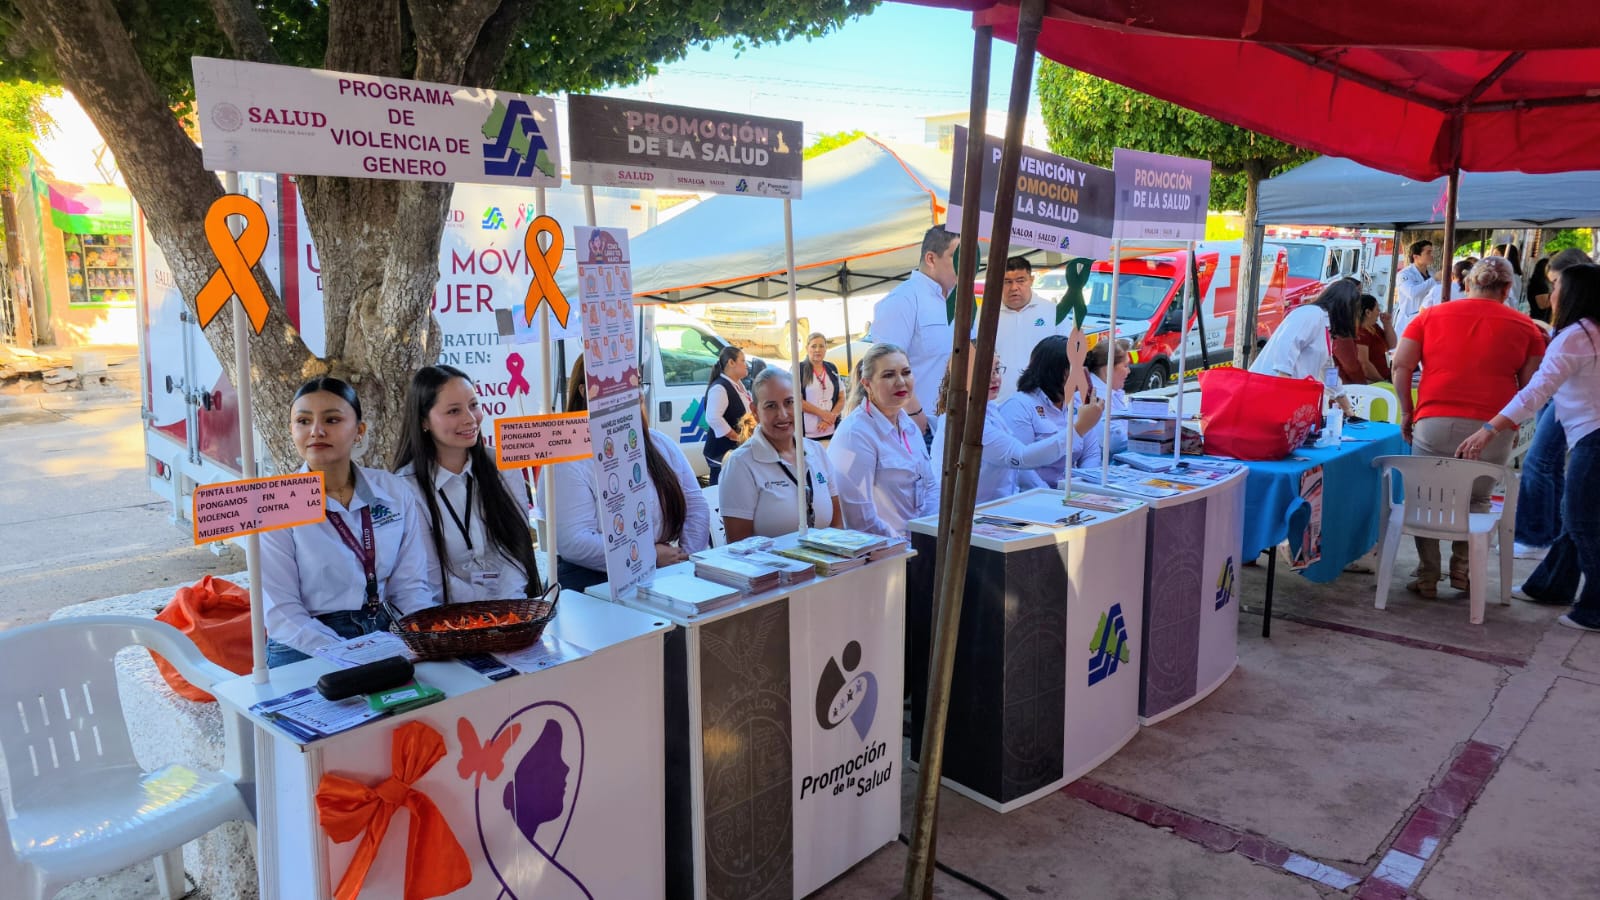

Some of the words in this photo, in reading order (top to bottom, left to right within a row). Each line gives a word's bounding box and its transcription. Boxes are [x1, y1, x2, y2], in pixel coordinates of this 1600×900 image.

[339, 79, 454, 106] PROGRAMA
[248, 107, 327, 128] SALUD
[388, 109, 415, 126] DE
[627, 110, 769, 145] PROMOCIÓN
[330, 128, 441, 152] VIOLENCIA
[446, 138, 470, 154] DE
[628, 135, 660, 156] DE
[666, 138, 696, 159] LA
[701, 142, 769, 166] SALUD
[363, 156, 446, 176] GENERO
[992, 148, 1074, 184] PVENCIÓN
[1078, 171, 1086, 187] Y
[618, 170, 654, 183] SALUD
[1134, 169, 1192, 191] PROMOCIÓN
[1018, 175, 1078, 204] OMOCIÓN
[1017, 196, 1034, 214] LA
[1038, 201, 1079, 223] SALUD
[1133, 190, 1146, 208] DE
[1148, 191, 1160, 209] LA
[1162, 193, 1191, 210] SALUD
[1011, 227, 1033, 239] NALOA
[1038, 232, 1056, 243] SALUD
[452, 242, 529, 275] MÓVI
[444, 333, 500, 347] RATUIT
[465, 351, 491, 364] EN:
[532, 420, 556, 428] MUNDO
[502, 442, 535, 450] VIOLENCIA
[548, 438, 572, 446] CONTRA
[502, 454, 530, 462] MUJERES
[226, 486, 234, 495] EL
[236, 482, 267, 492] MUNDO
[269, 480, 279, 489] DE
[262, 493, 275, 502] FIN
[290, 490, 296, 498] A
[198, 511, 240, 523] VIOLENCIA
[257, 503, 289, 513] CONTRA
[307, 499, 321, 507] LAS
[198, 525, 234, 538] MUJERES
[800, 740, 886, 800] Promoción
[833, 782, 844, 796] de
[847, 777, 855, 789] la
[857, 762, 892, 797] Salud
